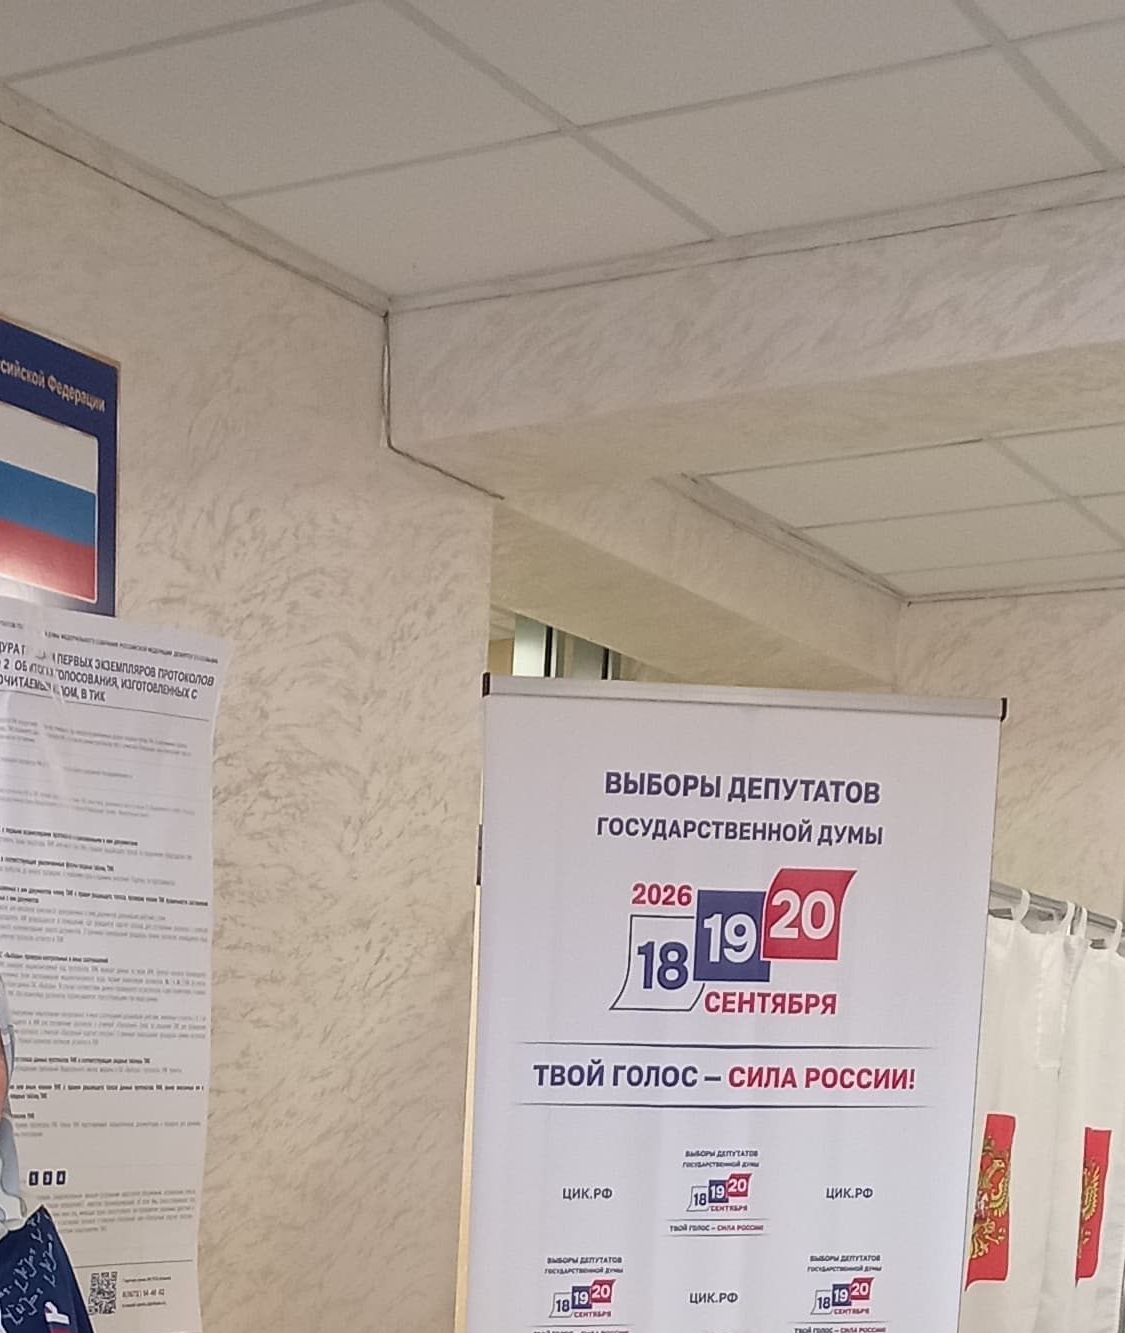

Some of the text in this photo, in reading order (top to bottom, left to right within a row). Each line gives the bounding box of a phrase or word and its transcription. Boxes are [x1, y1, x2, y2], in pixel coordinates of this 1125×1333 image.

[46, 375, 106, 413] Федерации
[4, 658, 9, 670] 2
[57, 653, 92, 669] ПЕРВЫХ
[158, 667, 214, 687] ПРОТОКОЛОВ
[89, 689, 106, 702] ТИК
[605, 771, 881, 805] ВЫБОРЫ ДЕПУТАТОВ
[597, 816, 883, 846] ГОСУДАРСТВЕННОЙ ДУМЫ
[631, 883, 693, 906] 2026
[637, 890, 836, 990] 18 19 20
[704, 992, 837, 1015] СЕНТЯБРЯ
[533, 1060, 916, 1090] ТВОЙ ГОЛОС СИЛА РОССИИ!
[562, 1187, 613, 1200] ЦИК.РФ
[694, 1178, 747, 1206] 18 19 20
[826, 1187, 873, 1200] ЦИК.РФ
[556, 1285, 611, 1312] 18 19 20
[689, 1292, 738, 1304] ЦИК.РФ
[817, 1283, 869, 1309] 18 19 20
